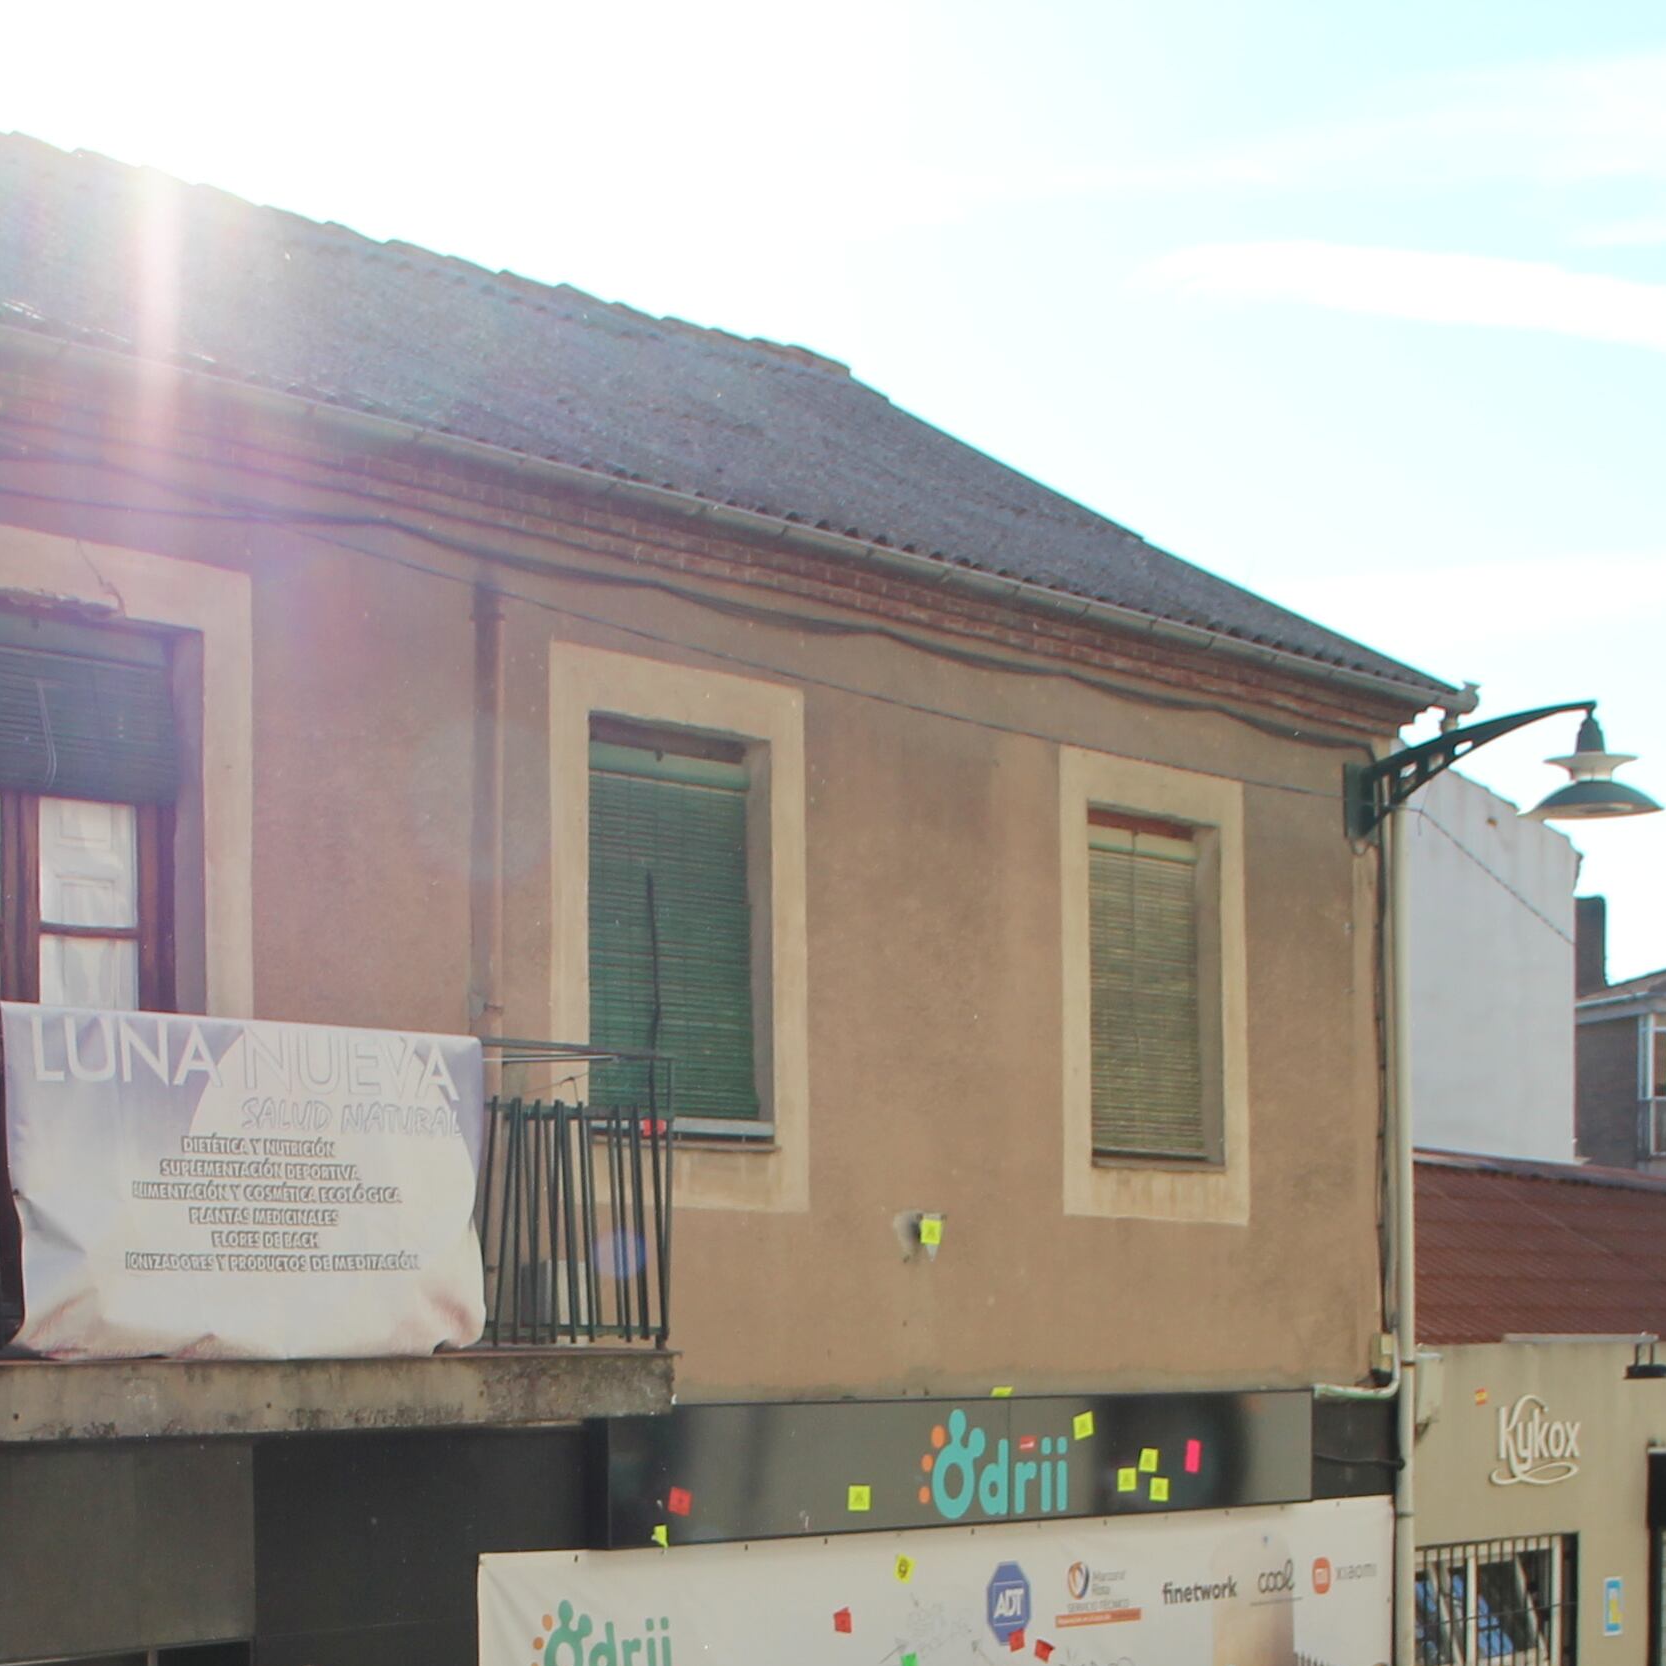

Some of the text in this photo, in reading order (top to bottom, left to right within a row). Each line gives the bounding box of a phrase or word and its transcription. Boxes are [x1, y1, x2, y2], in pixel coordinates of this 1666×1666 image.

[35, 1015, 459, 1102] LUNA NUEVA
[241, 1097, 463, 1138] SALUD NATURAL
[181, 1134, 336, 1158] DIETÉTICA Y NUTRICIÓN
[160, 1158, 361, 1182] SUPLEMENTACIÓN DEPORTIVA
[132, 1180, 403, 1204] ALIMENTACIÓN Y COSMÉTICA ECOLÓGICA
[188, 1207, 339, 1227] PLANTAS MEDICINALES
[211, 1231, 320, 1250] FLORES DE BACH
[125, 1250, 422, 1273] IONIZADORES Y PRODUCTOS DE MEDITACIÓN
[1490, 1394, 1581, 1486] Kykox
[1258, 1559, 1295, 1594] cool
[993, 1588, 1025, 1619] ADT
[1162, 1577, 1238, 1607] finetwork
